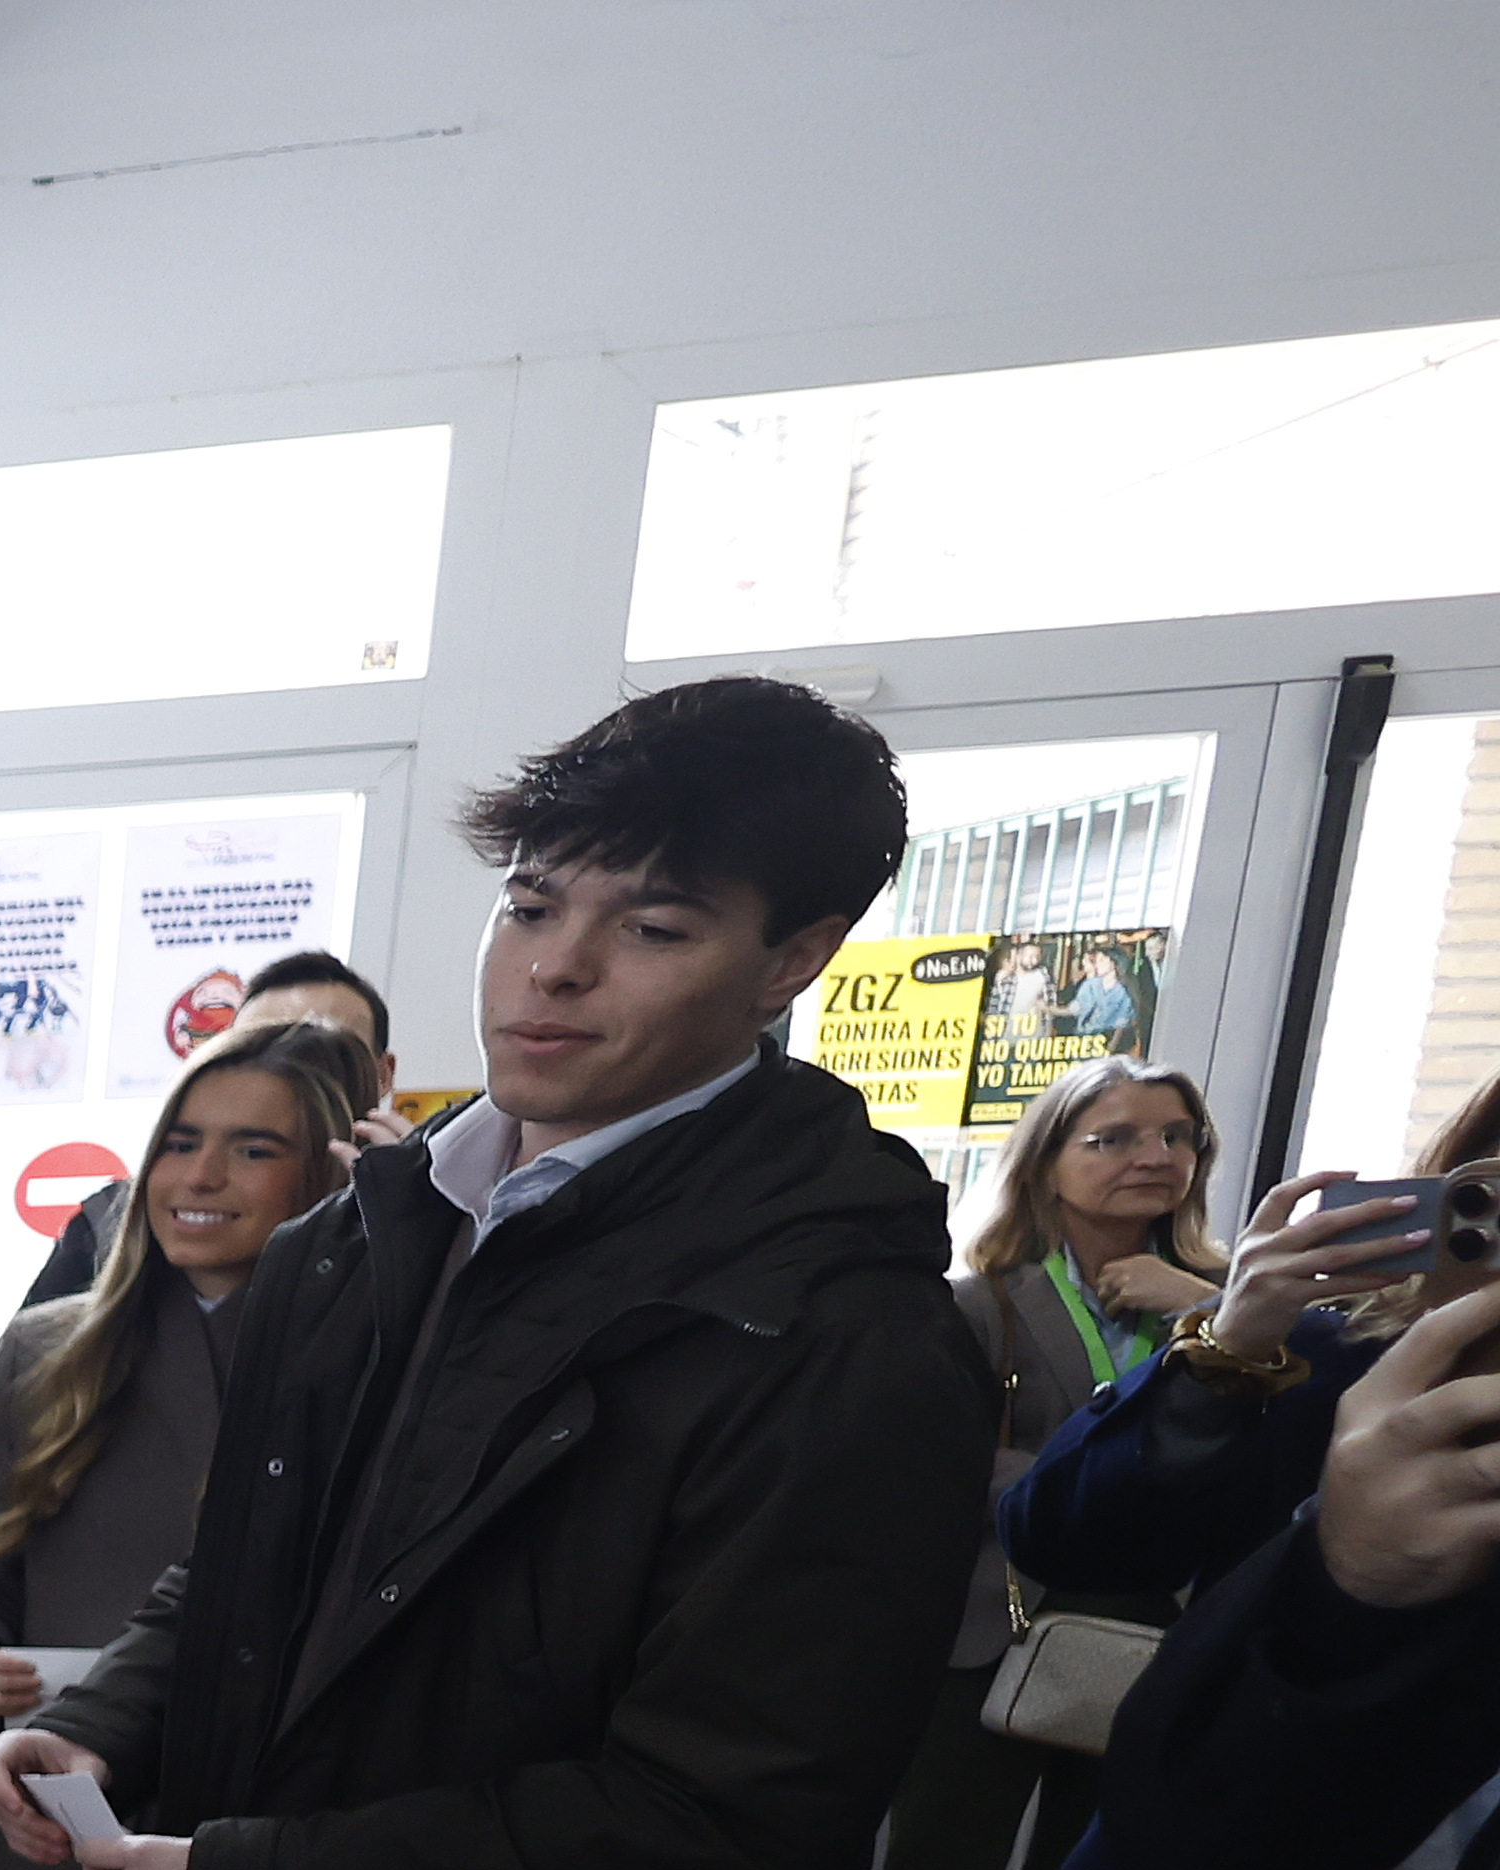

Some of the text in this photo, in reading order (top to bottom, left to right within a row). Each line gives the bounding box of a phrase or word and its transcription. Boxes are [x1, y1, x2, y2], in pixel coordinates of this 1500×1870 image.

[824, 973, 903, 1013] ZGZ
[819, 1018, 965, 1044] CONTRA LAS
[984, 1007, 1040, 1037] SI TÚ
[817, 1046, 962, 1073] AGRESIONES
[980, 1035, 1110, 1062] NO QUIERES,
[976, 1065, 1005, 1087] YO
